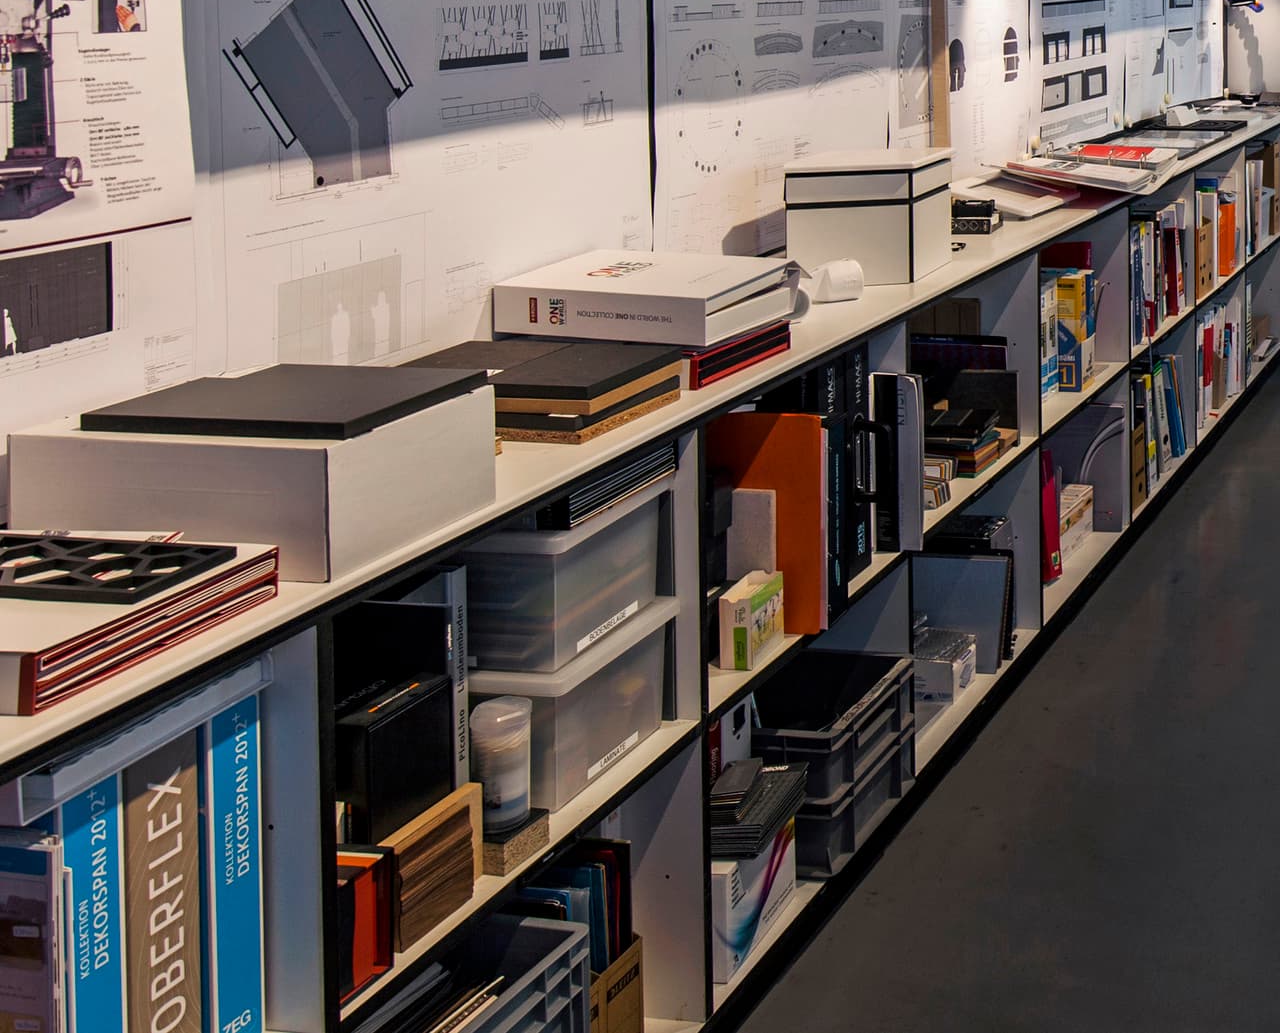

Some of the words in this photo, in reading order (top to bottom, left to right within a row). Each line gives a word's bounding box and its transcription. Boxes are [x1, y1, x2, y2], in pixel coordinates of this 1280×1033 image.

[576, 310, 614, 320] COLLECTION
[614, 312, 629, 320] ONE
[638, 314, 661, 322] WORLD
[660, 314, 673, 323] THE
[456, 605, 464, 694] Linoleumboden
[600, 742, 626, 768] LAMINATE
[225, 812, 233, 886] KOLLEKTION
[235, 766, 250, 877] DEKORSPAN
[91, 845, 110, 971] DEKORSPAN
[147, 766, 187, 1033] OBERFLEX
[79, 899, 89, 980] KOLLEKTION
